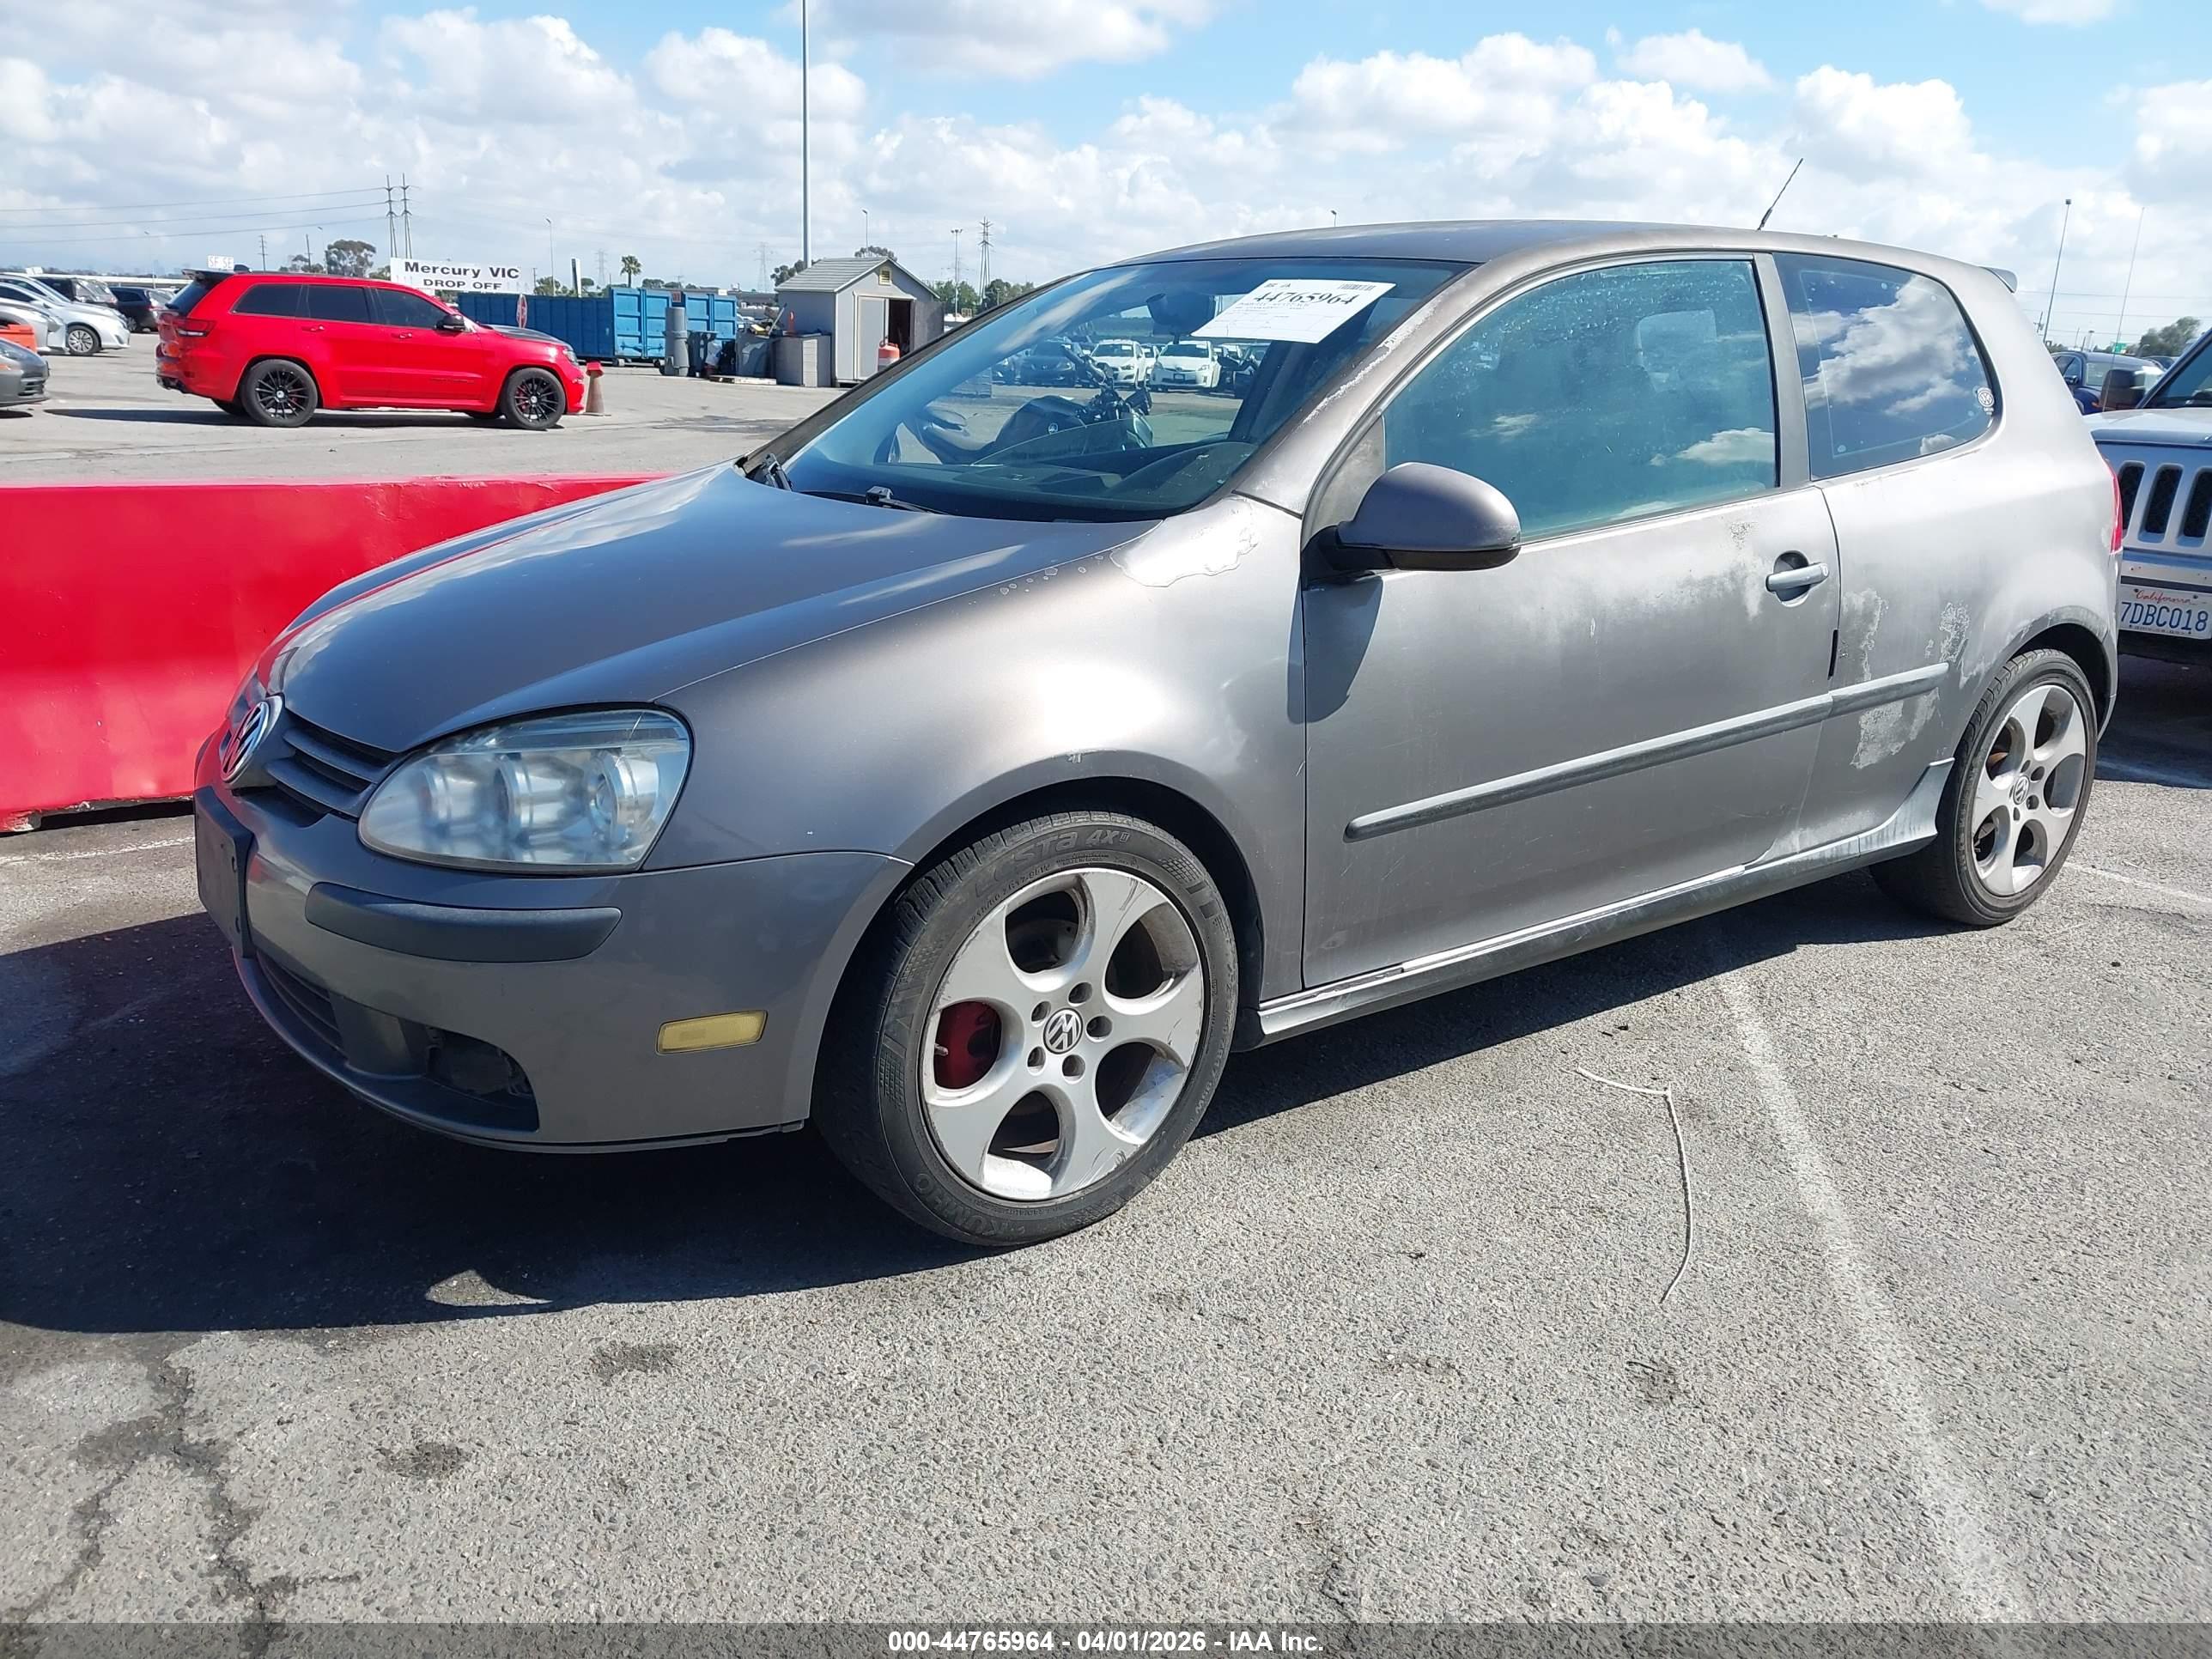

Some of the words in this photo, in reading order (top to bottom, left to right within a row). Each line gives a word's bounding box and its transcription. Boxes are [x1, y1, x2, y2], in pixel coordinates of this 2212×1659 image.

[404, 261, 481, 278] Mercury
[489, 266, 520, 278] VIC
[423, 278, 465, 289] DROP
[472, 282, 502, 290] OFF
[1254, 291, 1360, 305] 44765964
[2136, 590, 2191, 604] California
[2121, 601, 2209, 632] 7DBC018
